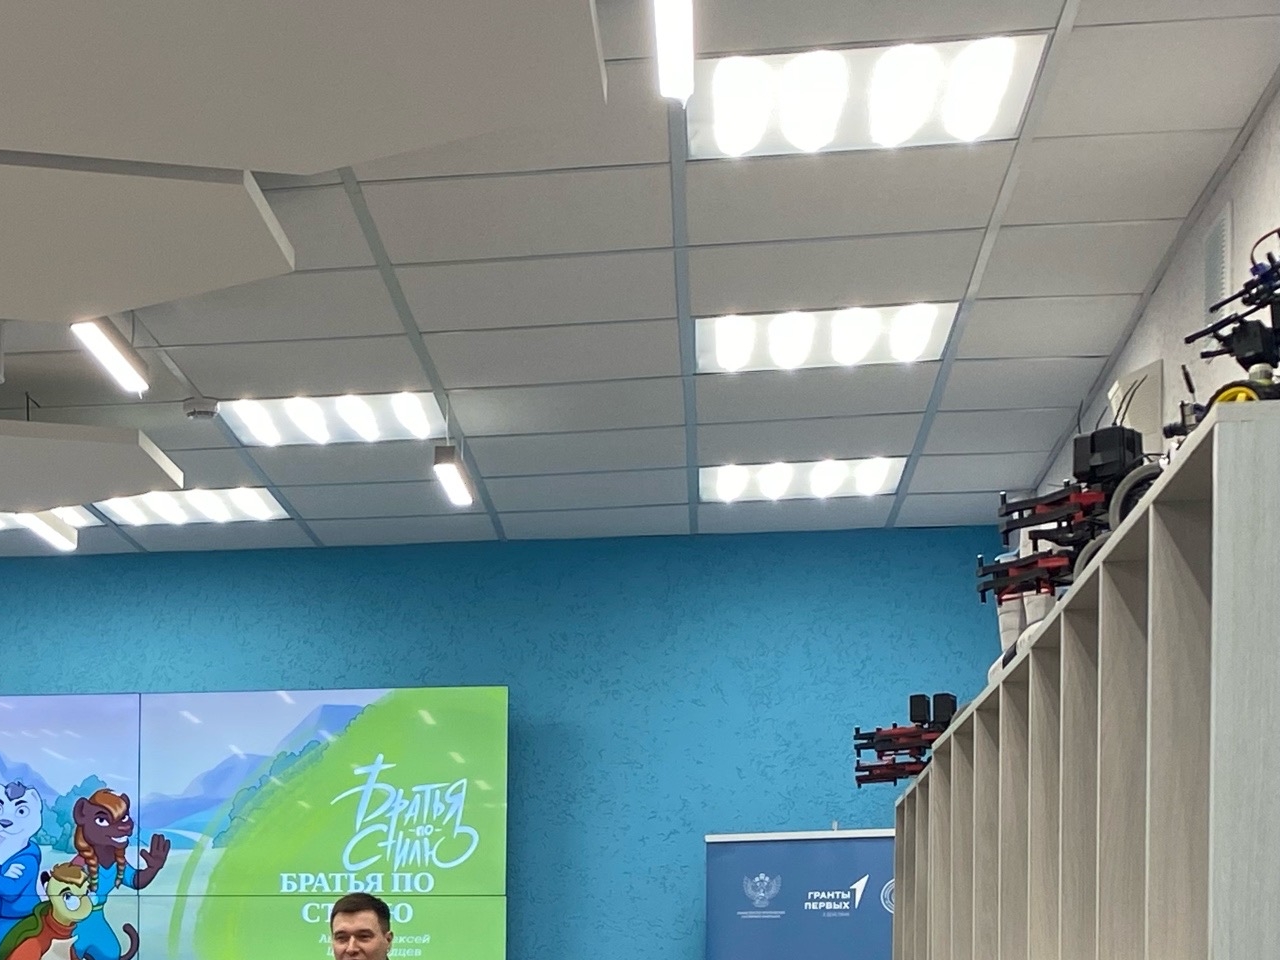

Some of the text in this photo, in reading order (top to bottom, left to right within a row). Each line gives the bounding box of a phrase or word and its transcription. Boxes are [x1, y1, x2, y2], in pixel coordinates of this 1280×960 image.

[280, 872, 435, 893] БРАТЬЯ ПО
[807, 890, 851, 900] ГРАНТЫ
[301, 902, 414, 923] СТЮ
[804, 901, 850, 910] ПЕРВЫХ
